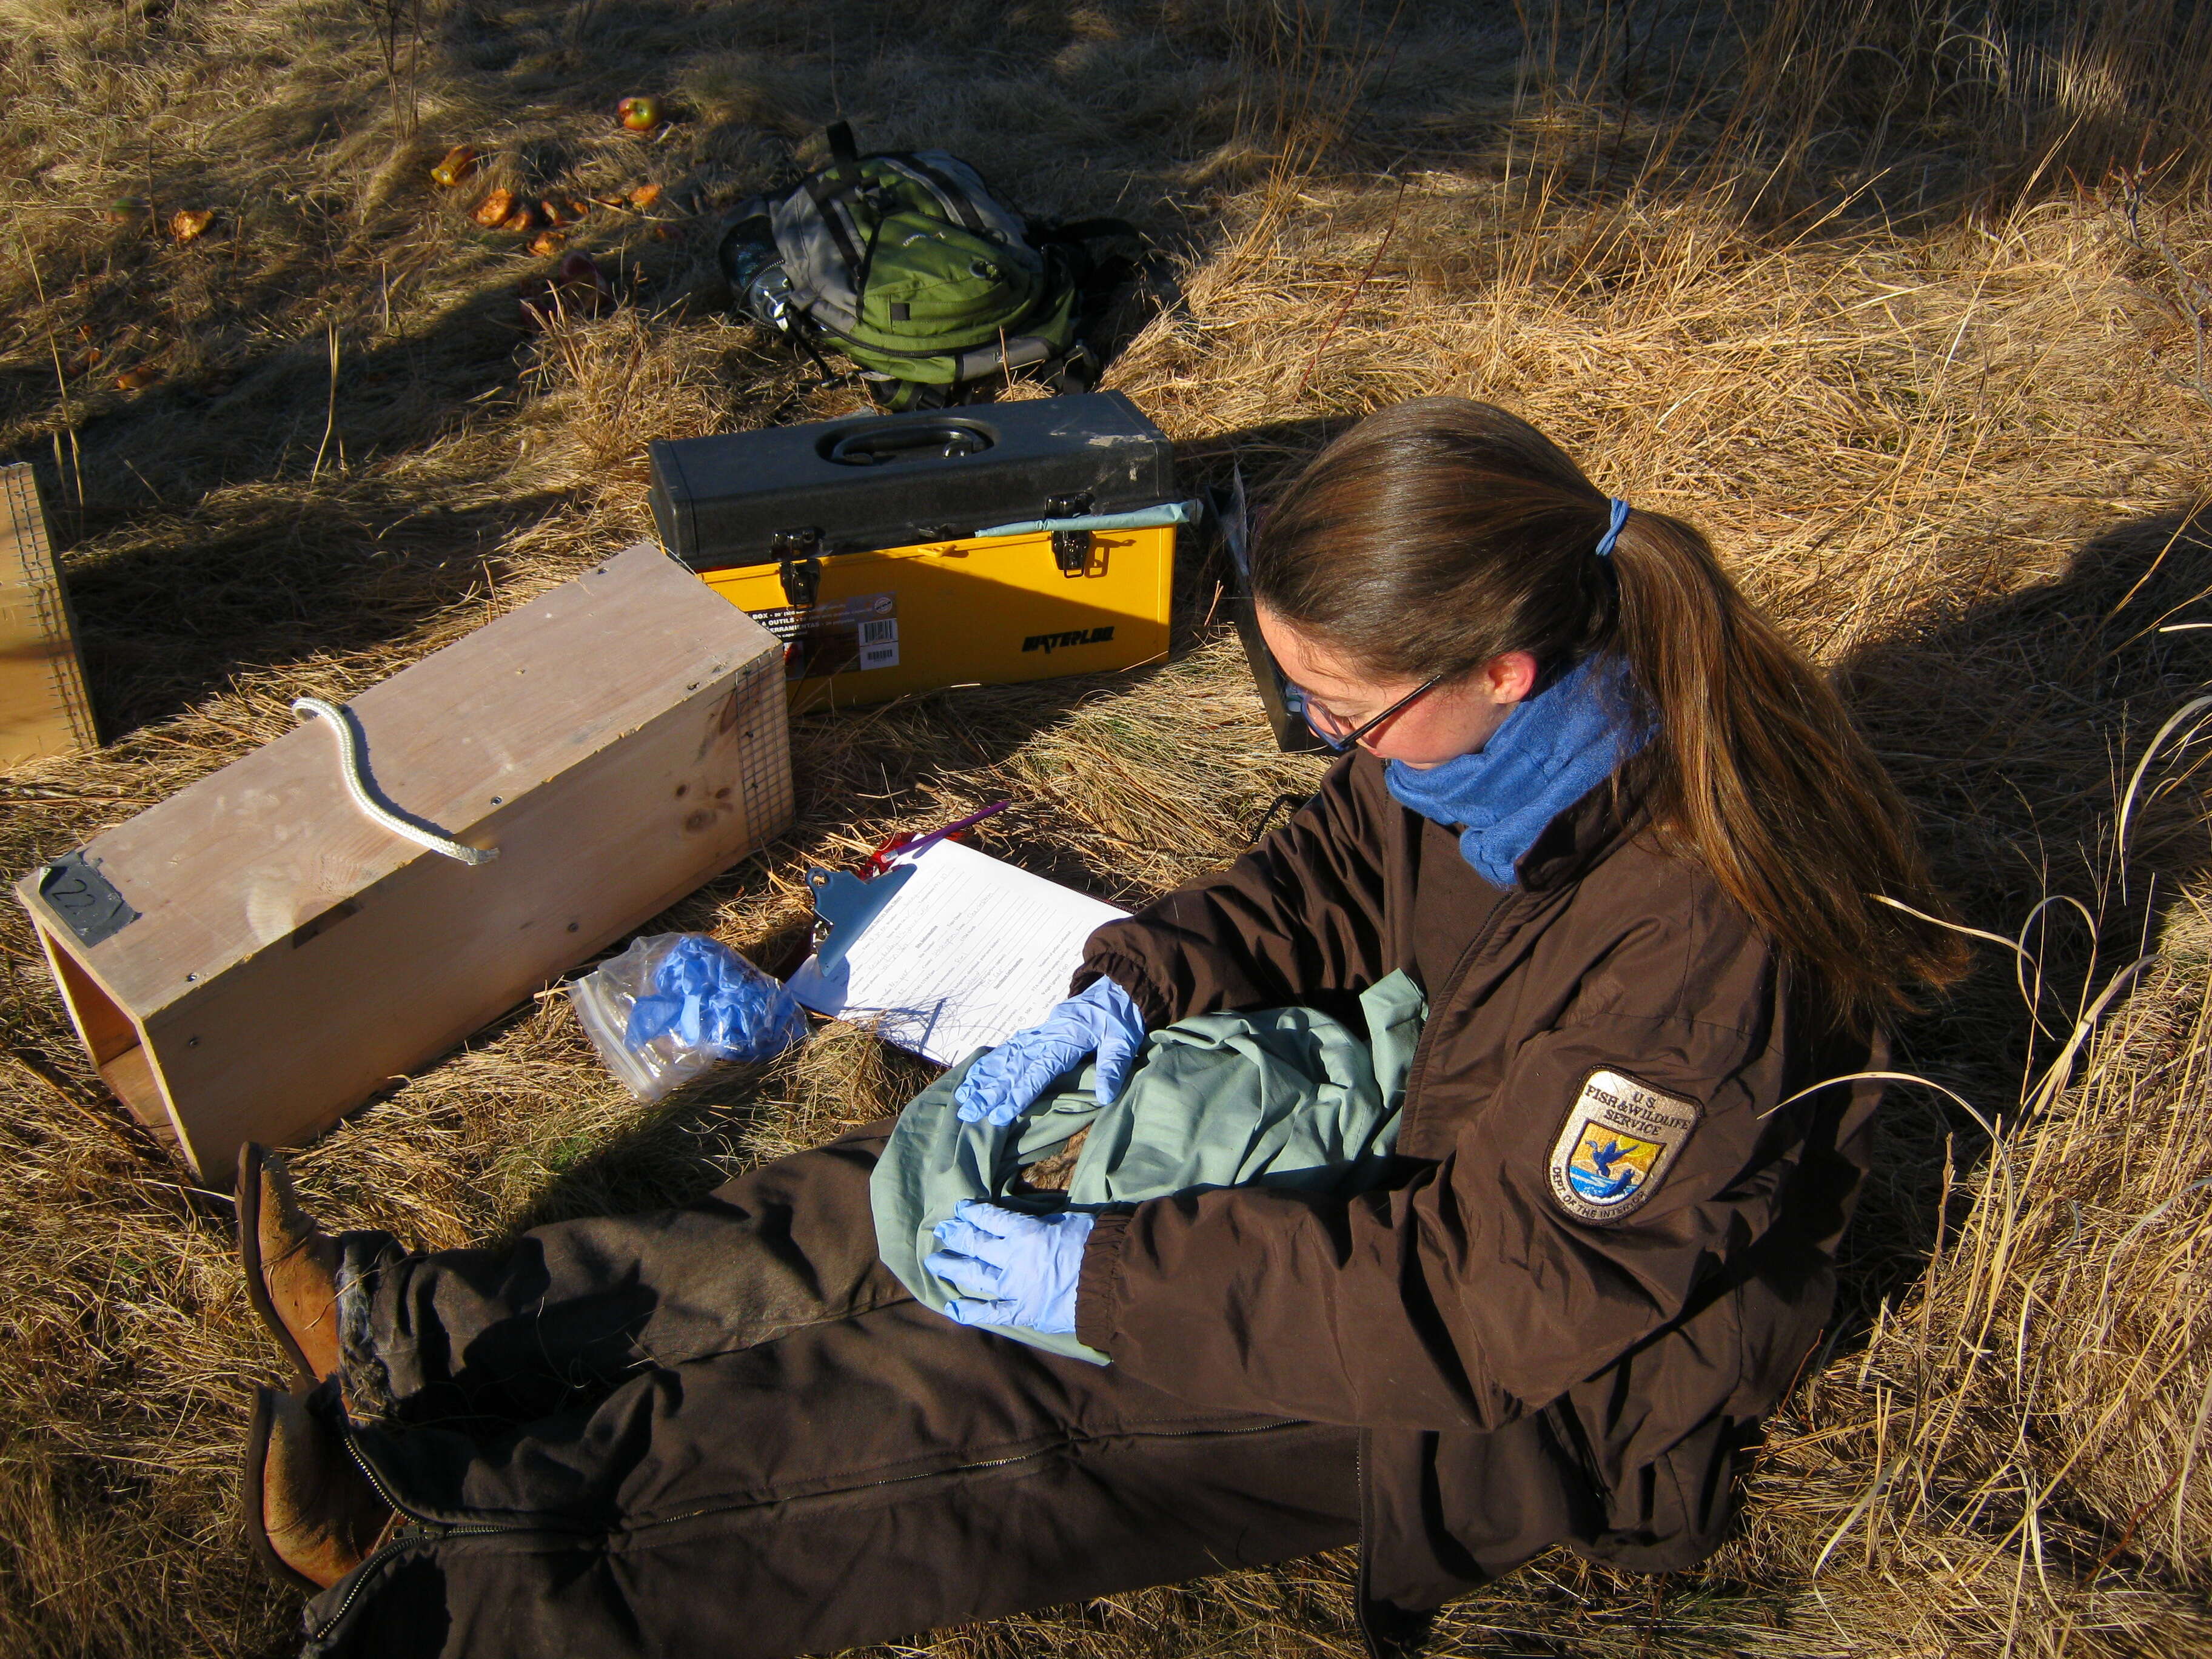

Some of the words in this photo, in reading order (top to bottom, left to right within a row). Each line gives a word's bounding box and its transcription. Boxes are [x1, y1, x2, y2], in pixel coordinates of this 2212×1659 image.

[768, 617, 795, 626] OUTILS
[1585, 1084, 1620, 1108] FISH
[1627, 1103, 1691, 1130] WILDLIFE
[1603, 1109, 1661, 1136] SERVICE
[1563, 1195, 1577, 1206] OF
[1577, 1205, 1597, 1218] THE
[1600, 1191, 1646, 1218] INTERIOR
